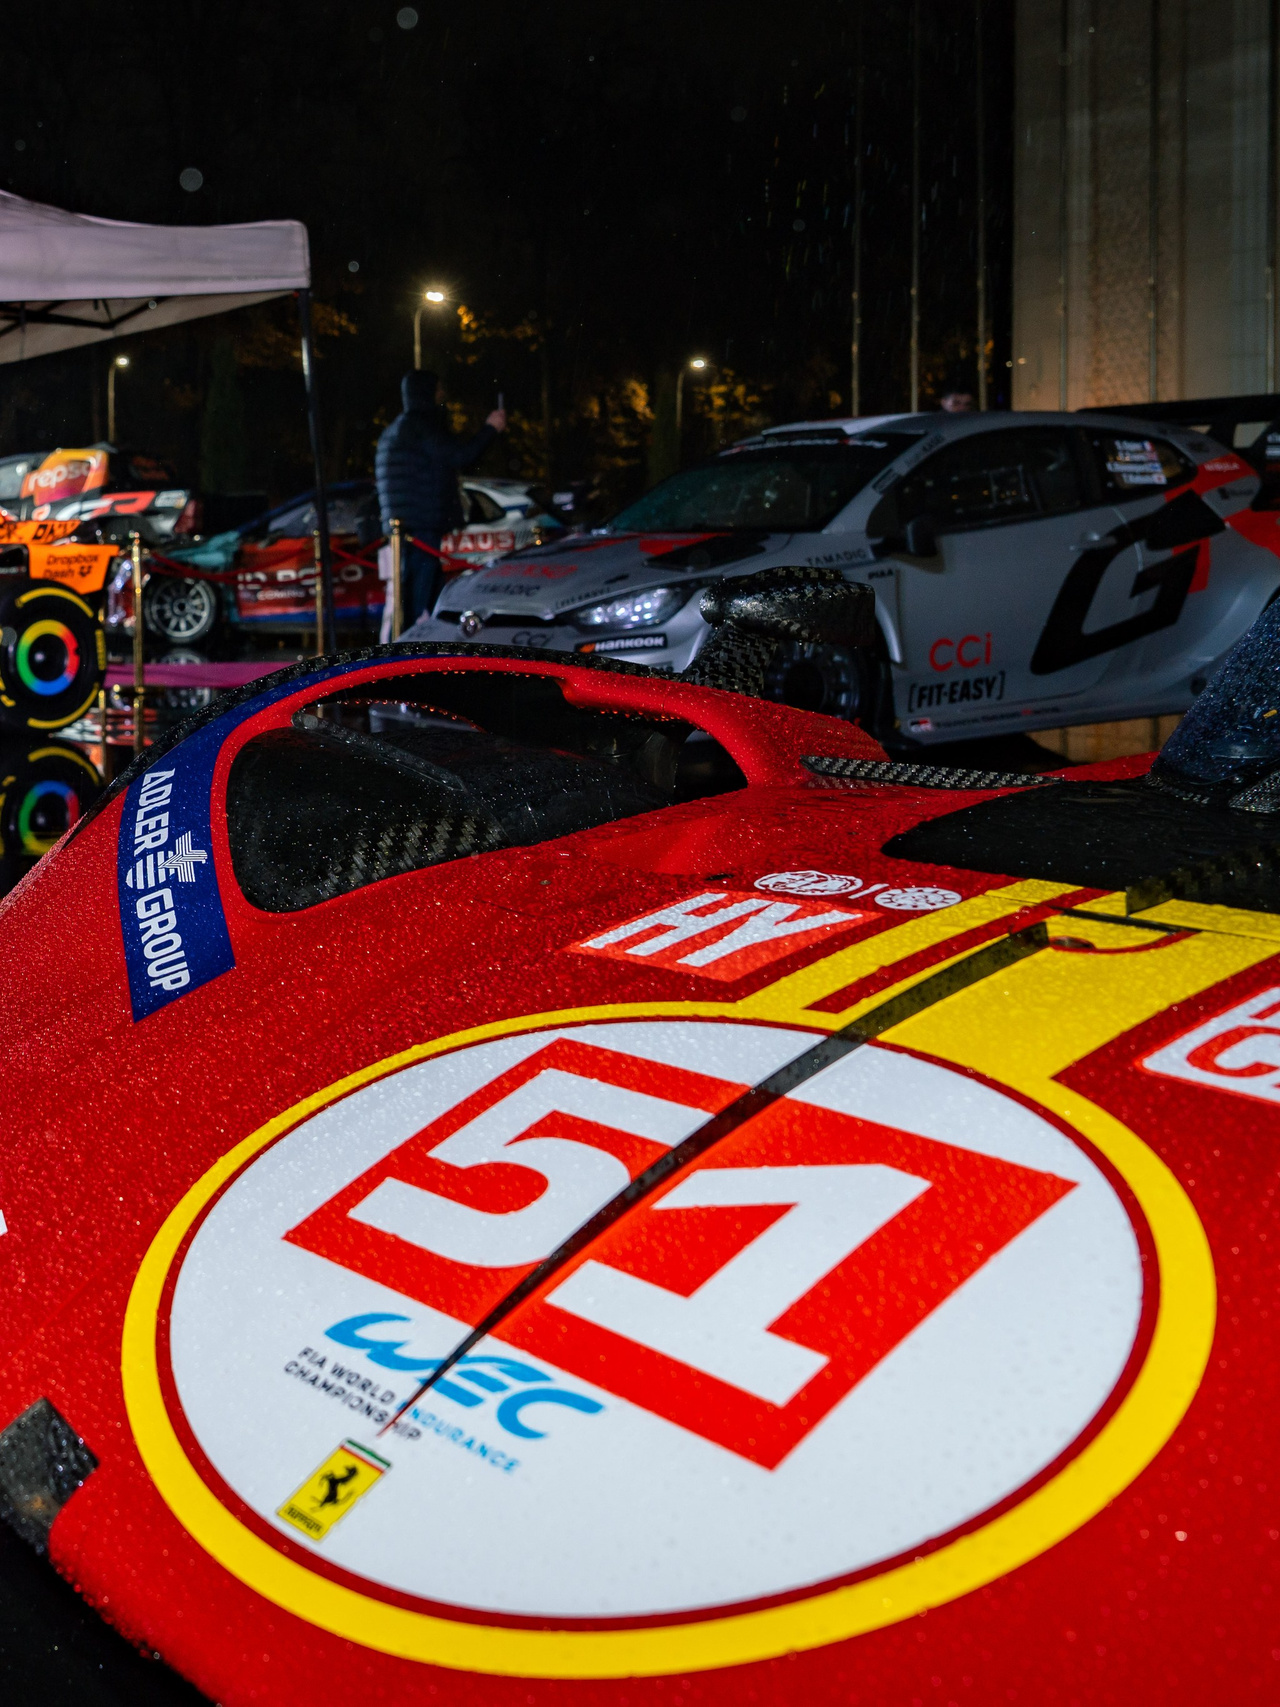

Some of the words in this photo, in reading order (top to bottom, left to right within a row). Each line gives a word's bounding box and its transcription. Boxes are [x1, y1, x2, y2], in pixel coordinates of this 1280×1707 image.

[43, 568, 75, 581] Dash
[46, 554, 100, 567] Dropbox
[276, 564, 363, 586] POO
[439, 532, 514, 553] HAUS
[134, 767, 176, 852] ADLER
[135, 888, 192, 991] GROUP
[580, 892, 864, 967] HY
[348, 1068, 934, 1407] 51
[297, 1346, 327, 1369] FIA
[329, 1361, 397, 1404] WORLD
[325, 1312, 605, 1440] WEC
